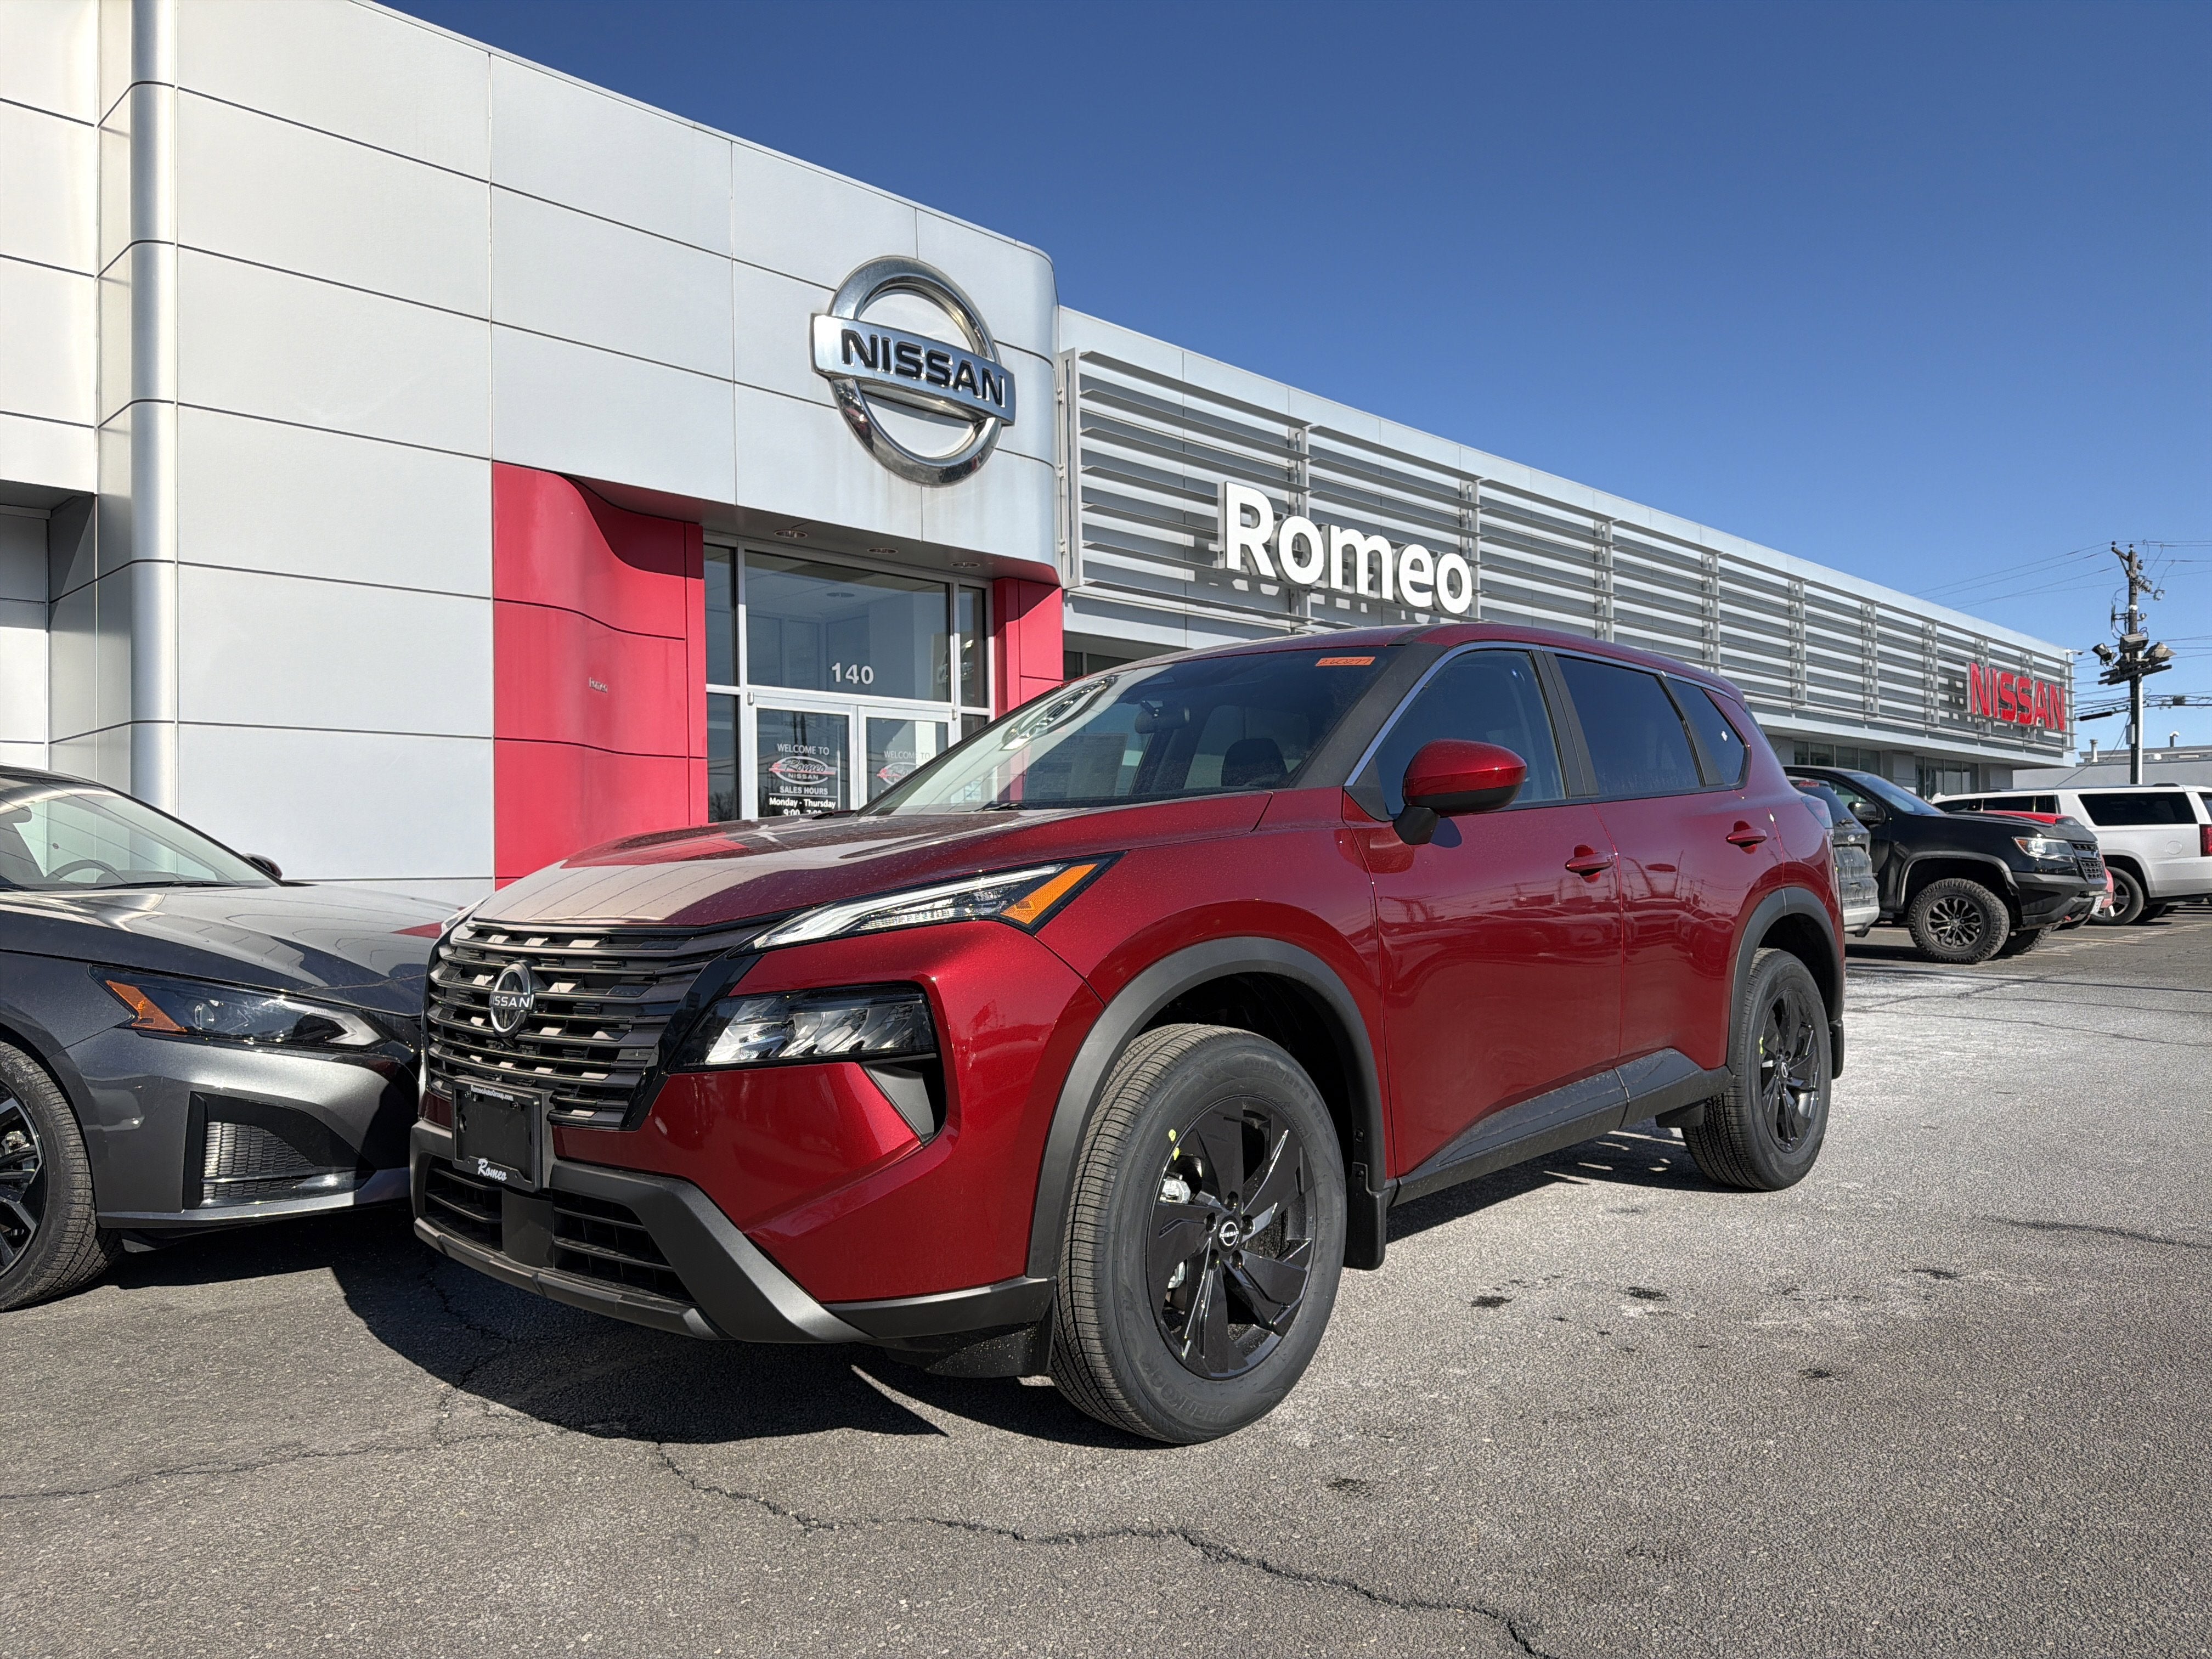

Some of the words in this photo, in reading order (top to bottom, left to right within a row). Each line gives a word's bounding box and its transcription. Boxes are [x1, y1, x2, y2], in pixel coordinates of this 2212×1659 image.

[840, 329, 1006, 408] NISSAN
[1223, 481, 1472, 614] Romeo
[832, 662, 873, 684] 140
[1968, 662, 2066, 731] NISSAN
[777, 743, 816, 755] WELCOME
[818, 746, 830, 755] TO
[884, 751, 917, 760] WELCOM
[782, 758, 826, 772] Romeo
[780, 786, 803, 794] SALES
[804, 787, 828, 795] HOURS
[769, 797, 798, 808] Monday
[803, 798, 836, 809] Thursday
[477, 1158, 507, 1182] Romeo
